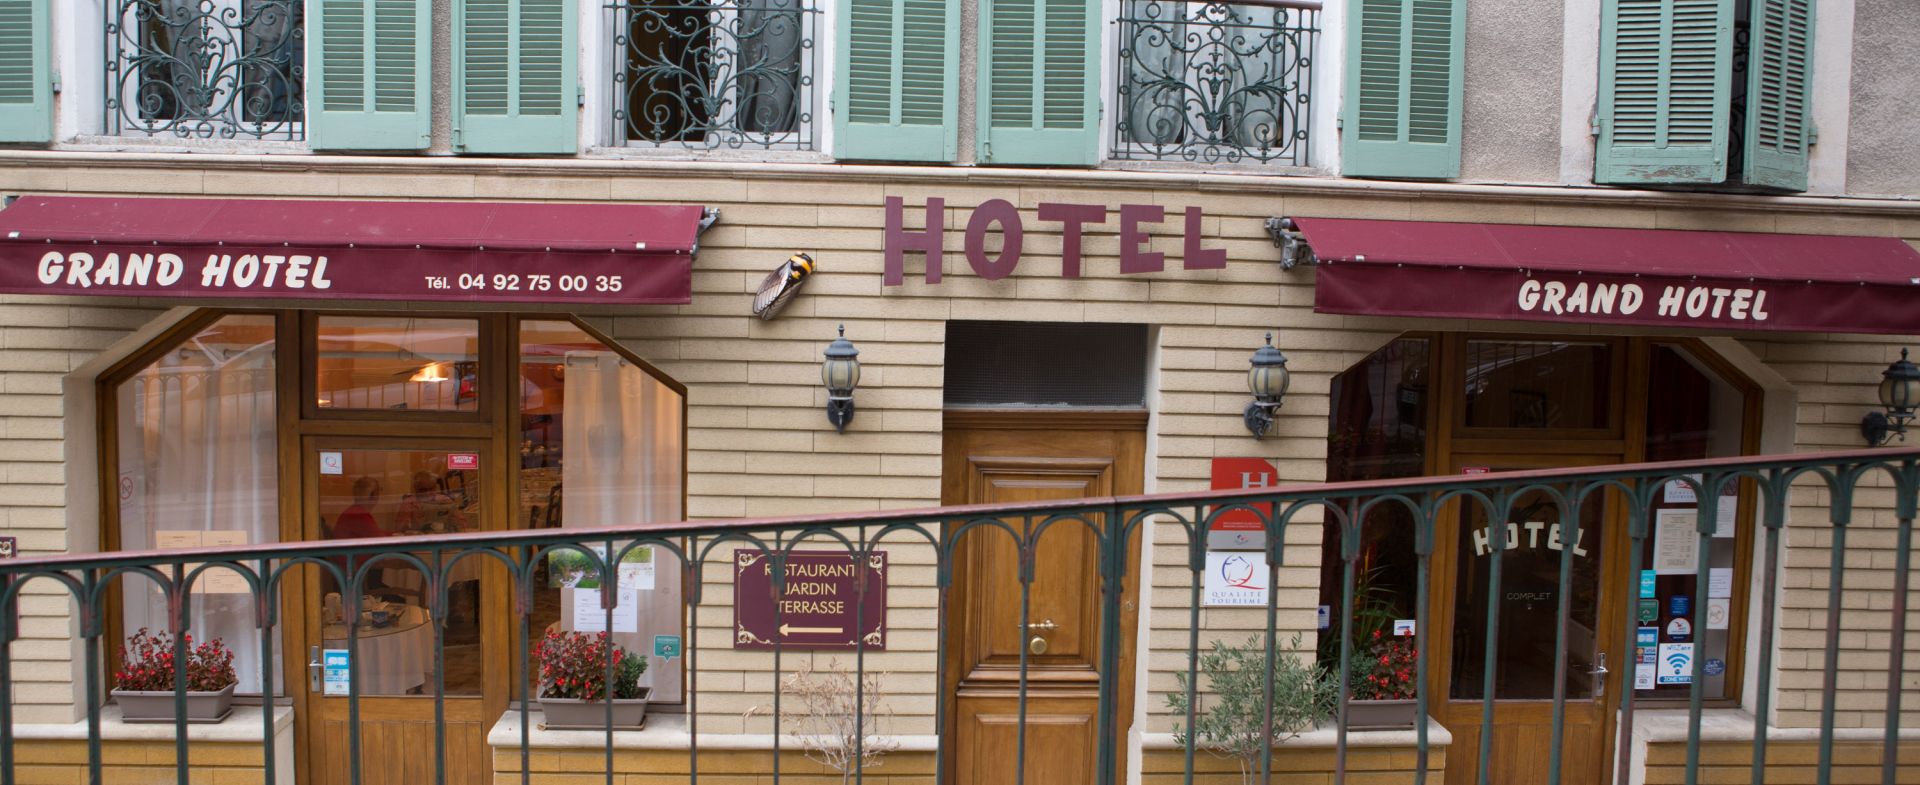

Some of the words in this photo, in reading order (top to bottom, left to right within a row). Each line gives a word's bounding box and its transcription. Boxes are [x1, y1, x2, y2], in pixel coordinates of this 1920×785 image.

[884, 196, 1227, 286] HOTEL
[38, 251, 184, 288] GRAND
[201, 254, 331, 289] HOTEL
[425, 276, 451, 289] Tél.
[458, 273, 485, 290] 04
[493, 274, 520, 291] 92
[527, 274, 551, 291] 75
[559, 275, 588, 291] 00
[595, 275, 622, 292] 35
[1518, 279, 1644, 315] GRAND
[1658, 286, 1768, 320] HOTEL
[764, 563, 855, 577] RSTAURANT
[784, 582, 837, 596] JARDIN
[1506, 592, 1552, 600] COMPLET
[777, 600, 844, 614] TERRASSE
